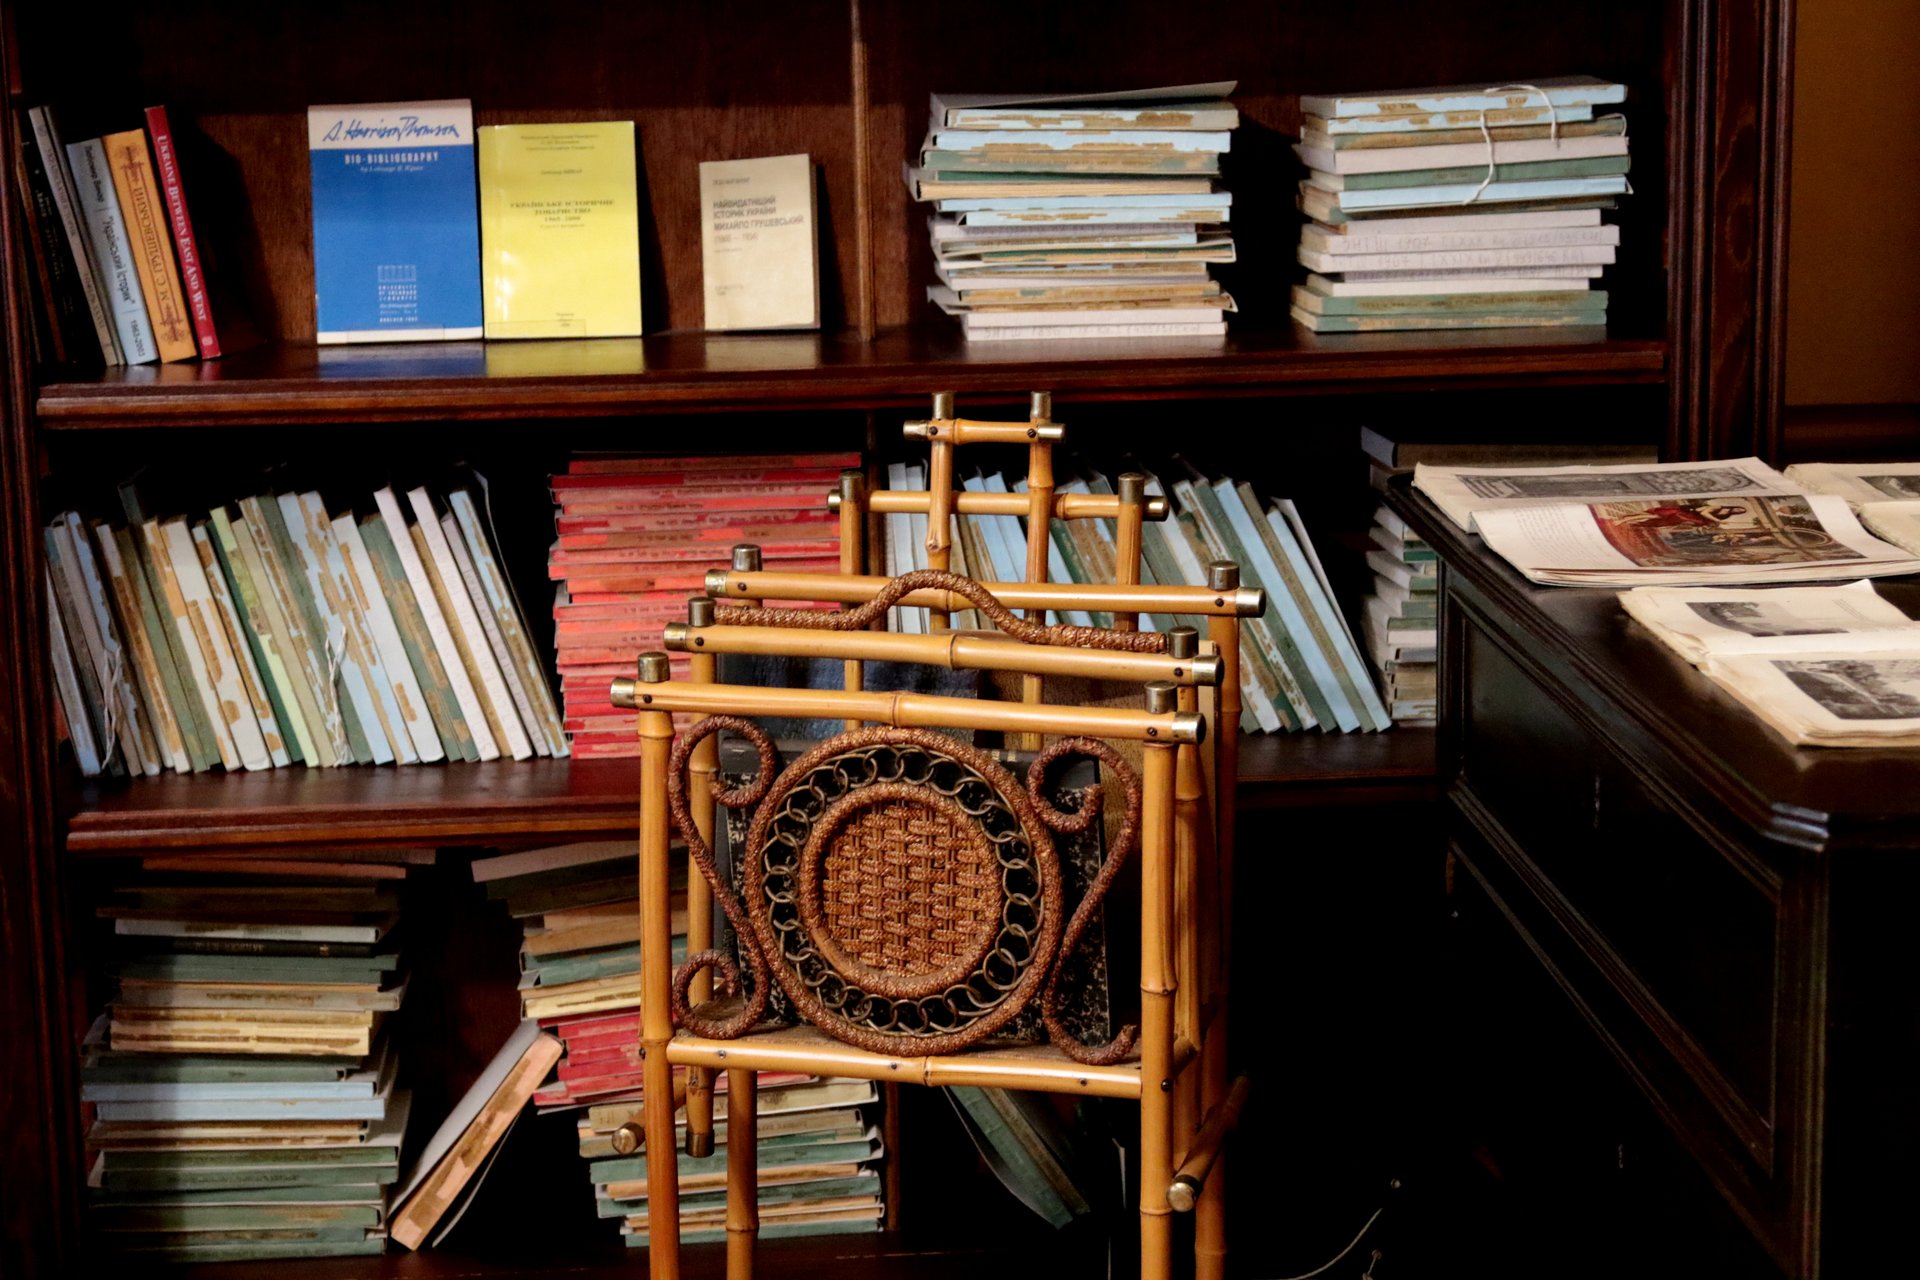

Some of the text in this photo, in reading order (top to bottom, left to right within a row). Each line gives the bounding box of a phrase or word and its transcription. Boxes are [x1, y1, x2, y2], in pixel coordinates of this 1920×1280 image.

[343, 118, 402, 141] Harrison
[400, 116, 460, 138] Thomson
[135, 186, 165, 273] ГРУШЕВСЬКИЙ
[155, 134, 208, 321] UKRAINE BETWEEN EAST AND WEST
[714, 214, 804, 231] МИХАЙЛО ГРУШЕВСЬКИЙ
